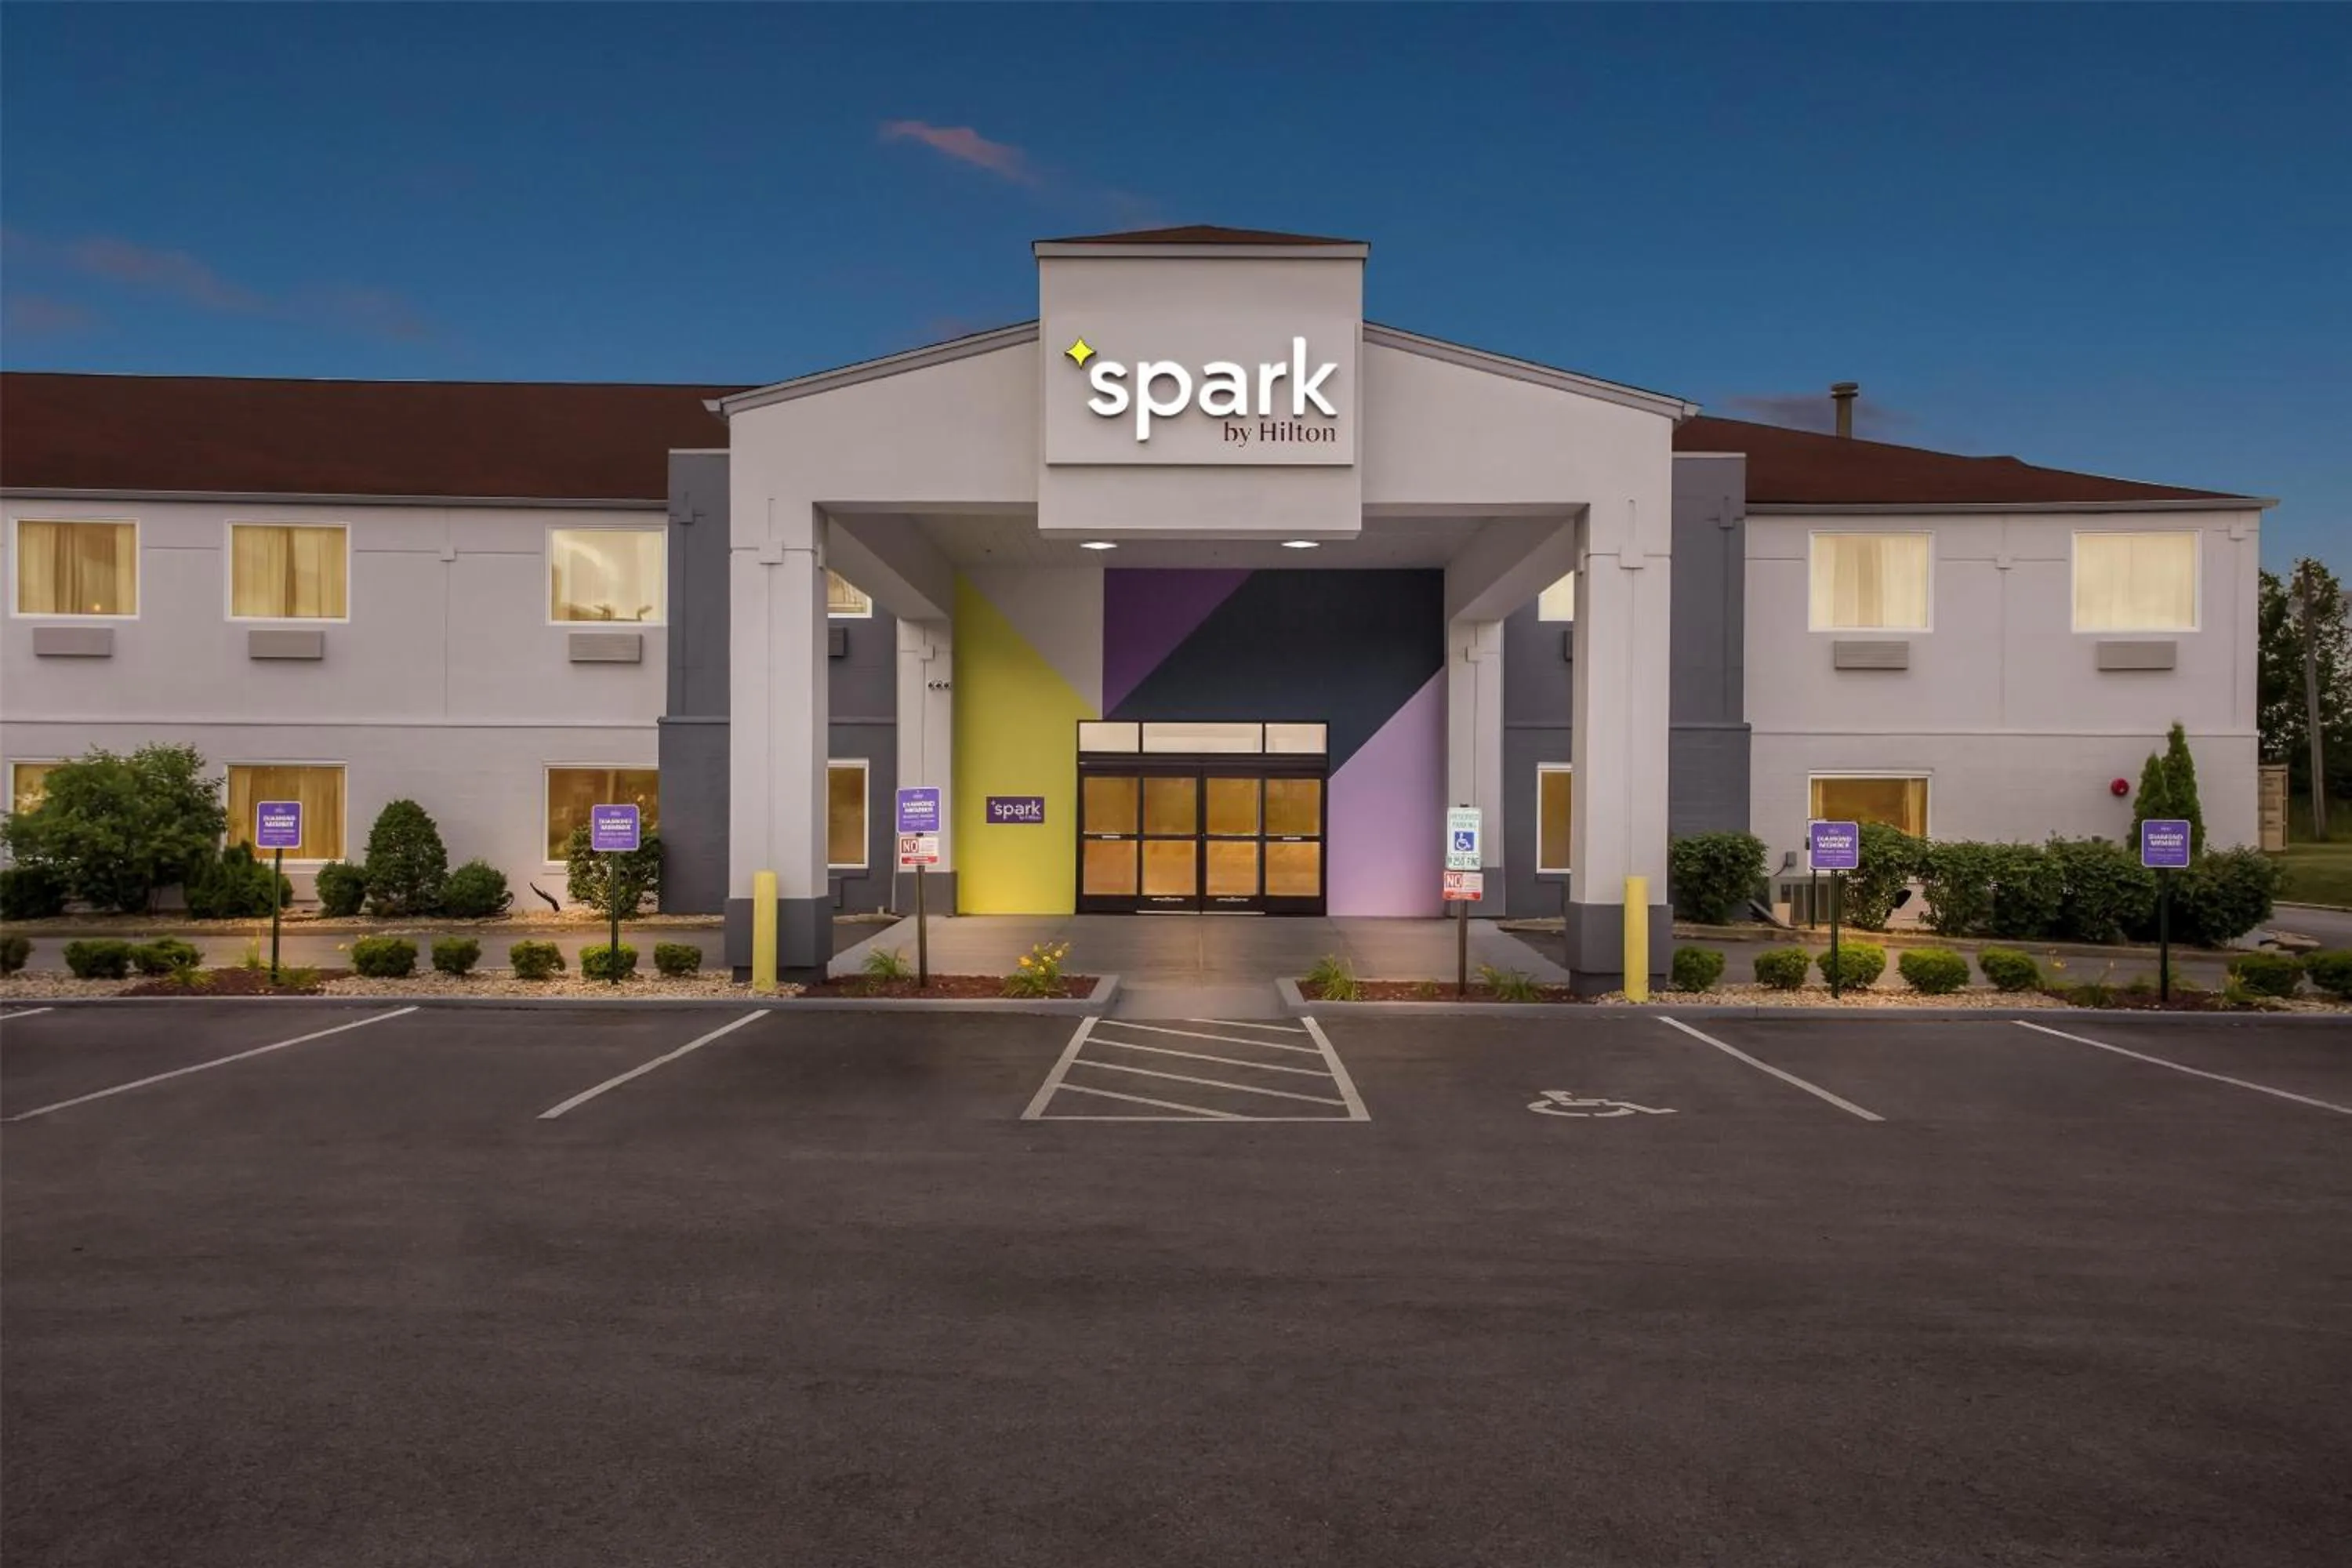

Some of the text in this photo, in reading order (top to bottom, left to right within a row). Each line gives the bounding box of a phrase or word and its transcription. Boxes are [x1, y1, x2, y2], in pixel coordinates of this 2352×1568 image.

[1087, 336, 1338, 443] spark
[1224, 421, 1336, 447] by Hilton
[994, 800, 1041, 821] spark
[902, 840, 918, 853] NO
[1446, 874, 1462, 887] NO
